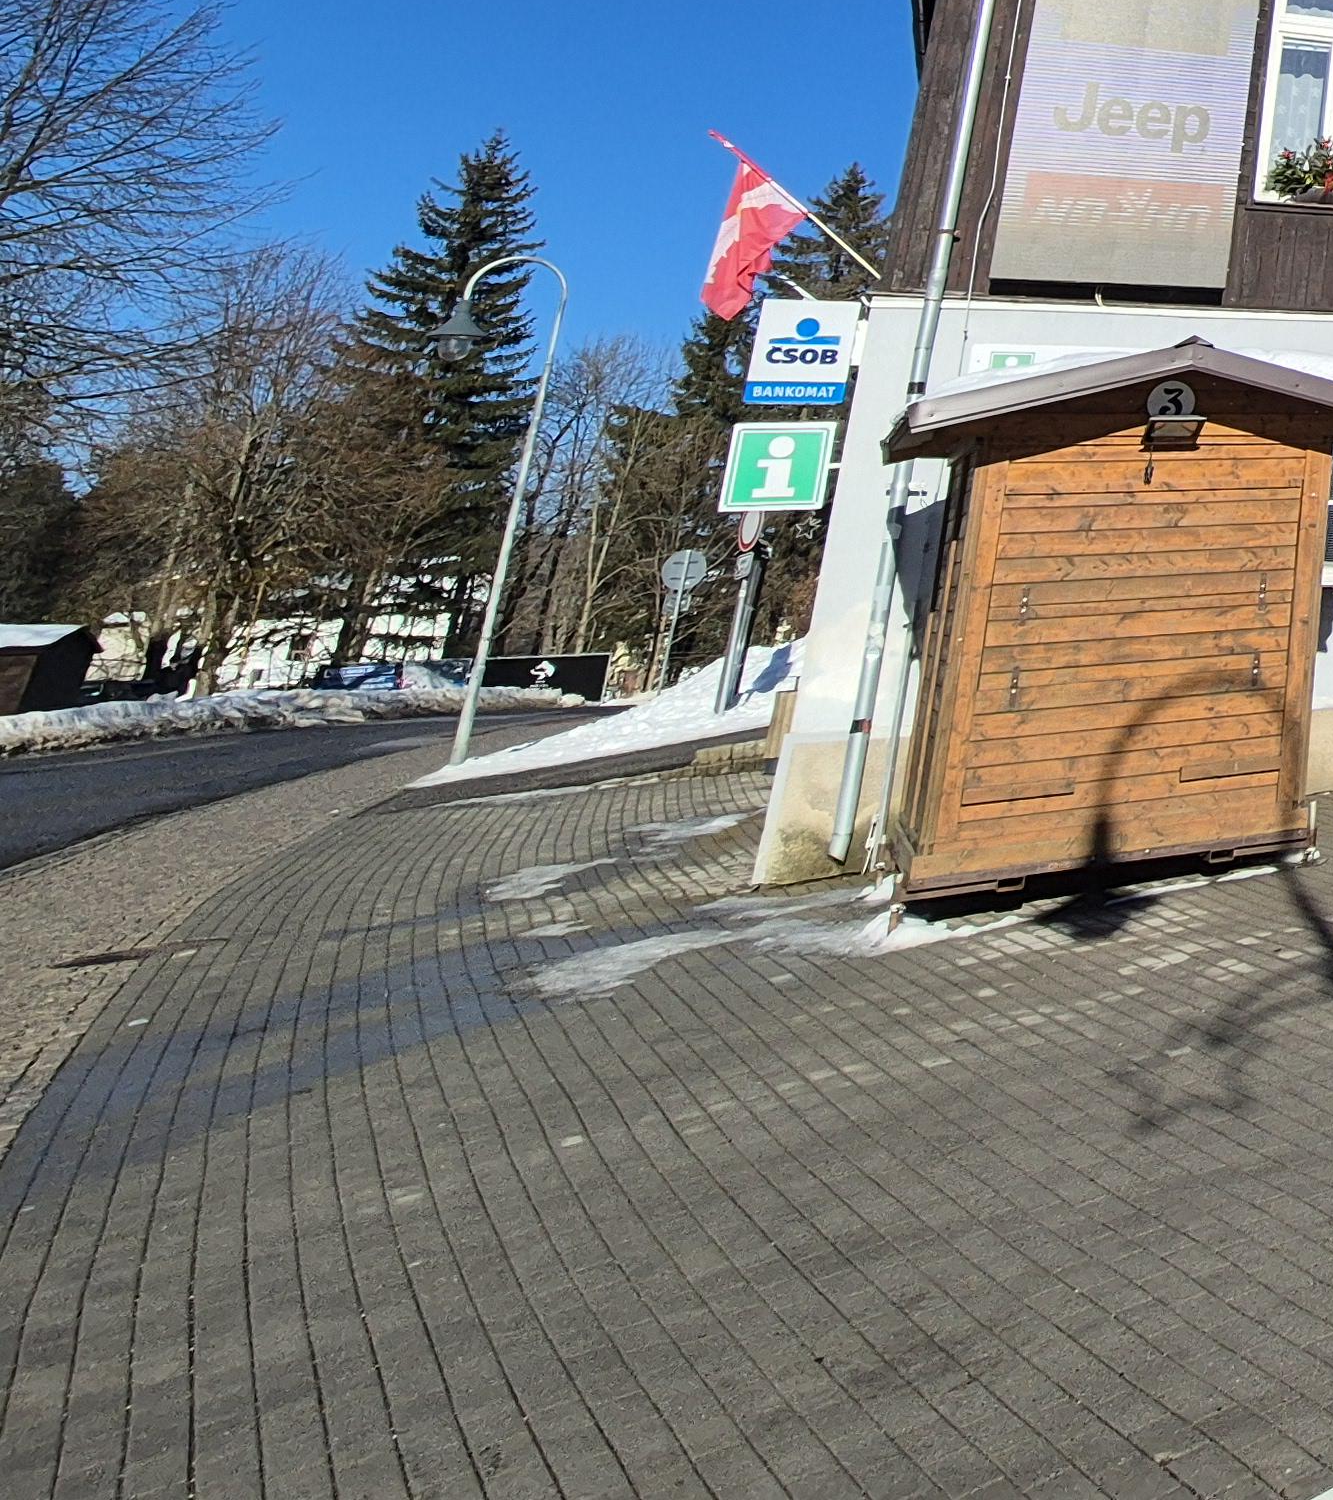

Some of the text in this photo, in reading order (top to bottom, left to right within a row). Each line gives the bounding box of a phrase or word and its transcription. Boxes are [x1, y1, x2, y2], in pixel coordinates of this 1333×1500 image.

[1053, 81, 1211, 153] Jeep
[766, 346, 839, 365] ČSOB
[752, 385, 836, 399] BANKOMAT
[1159, 388, 1184, 415] 3
